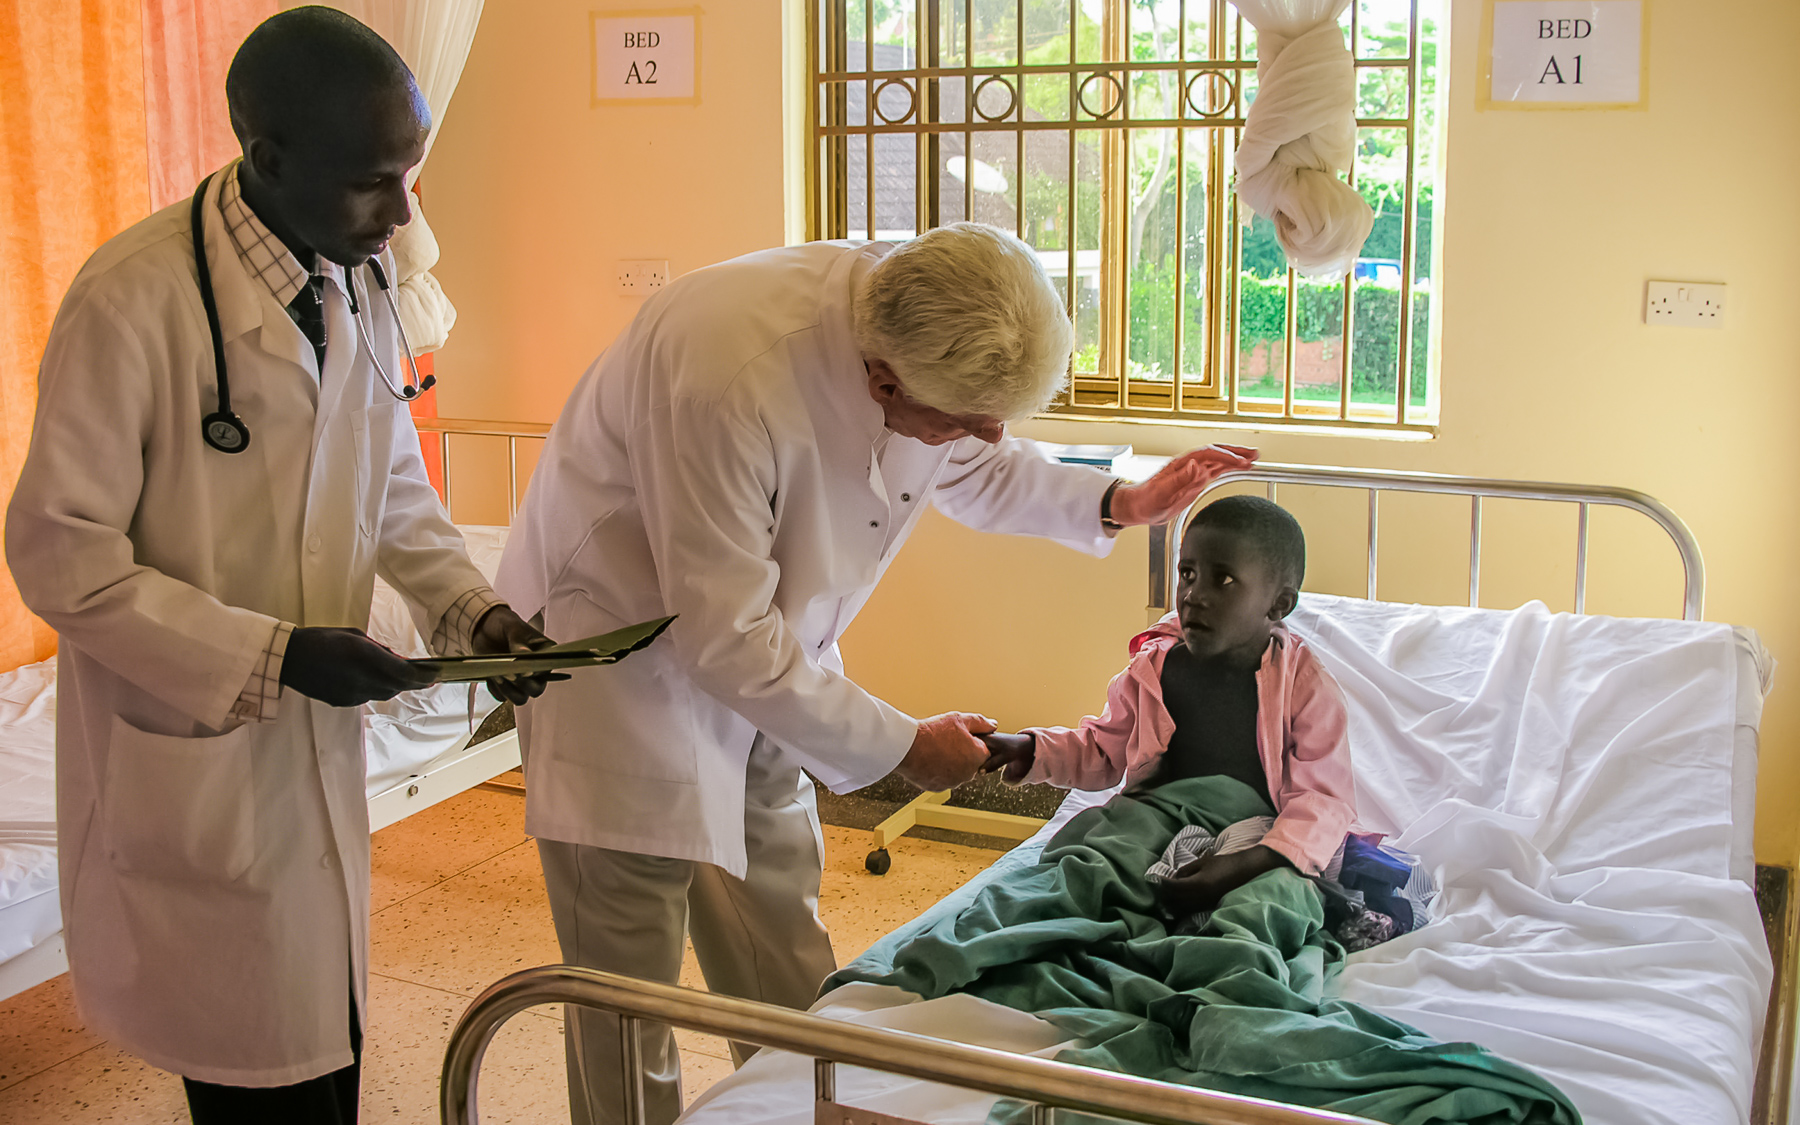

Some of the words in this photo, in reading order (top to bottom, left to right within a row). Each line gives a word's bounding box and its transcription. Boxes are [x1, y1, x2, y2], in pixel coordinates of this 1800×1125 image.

[624, 32, 660, 48] BED
[1538, 19, 1592, 39] BED
[624, 60, 658, 84] A2
[1537, 54, 1583, 84] A1
